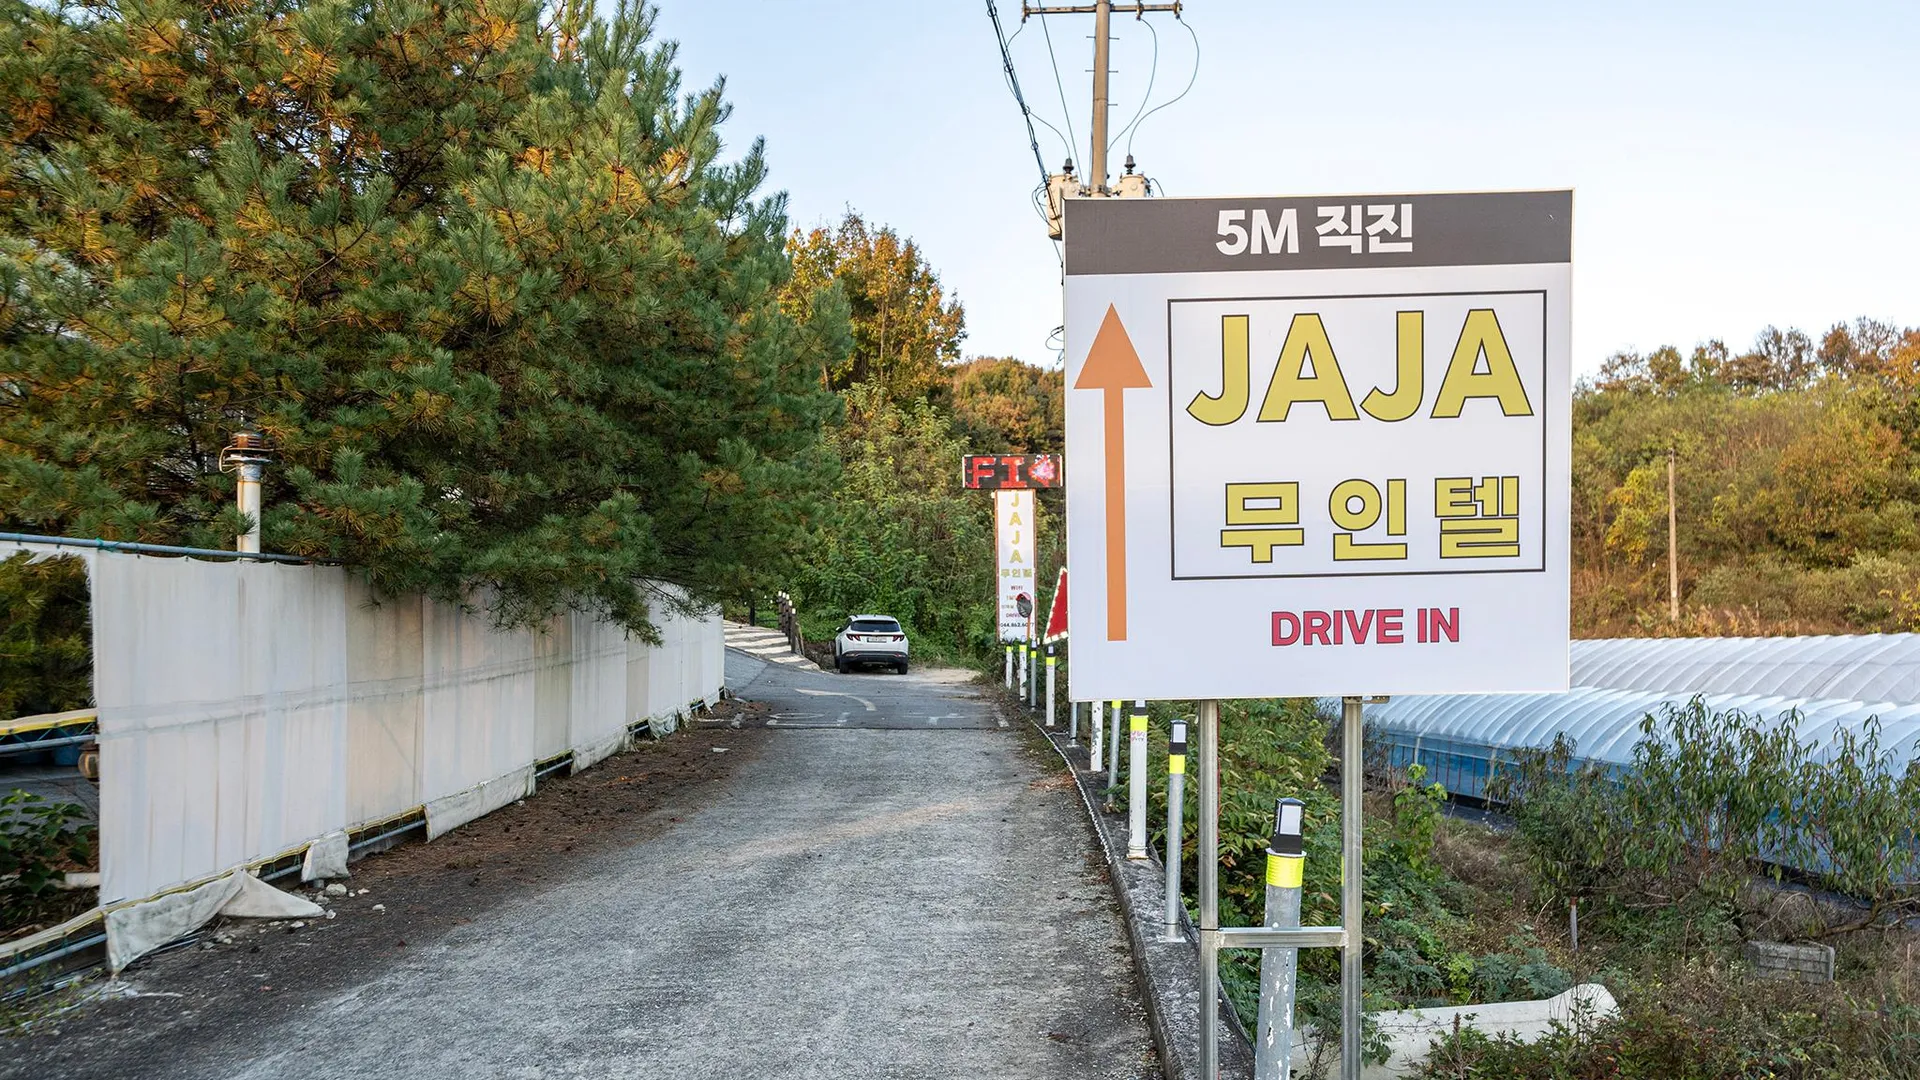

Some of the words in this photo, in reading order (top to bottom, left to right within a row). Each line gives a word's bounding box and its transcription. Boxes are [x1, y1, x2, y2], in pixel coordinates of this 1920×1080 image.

[1215, 208, 1299, 256] 5M
[1316, 203, 1413, 255] 직진
[1186, 308, 1534, 426] JAJA
[1220, 476, 1521, 563] 무인텔
[1271, 609, 1404, 646] DRIVE
[1417, 608, 1460, 643] IN
